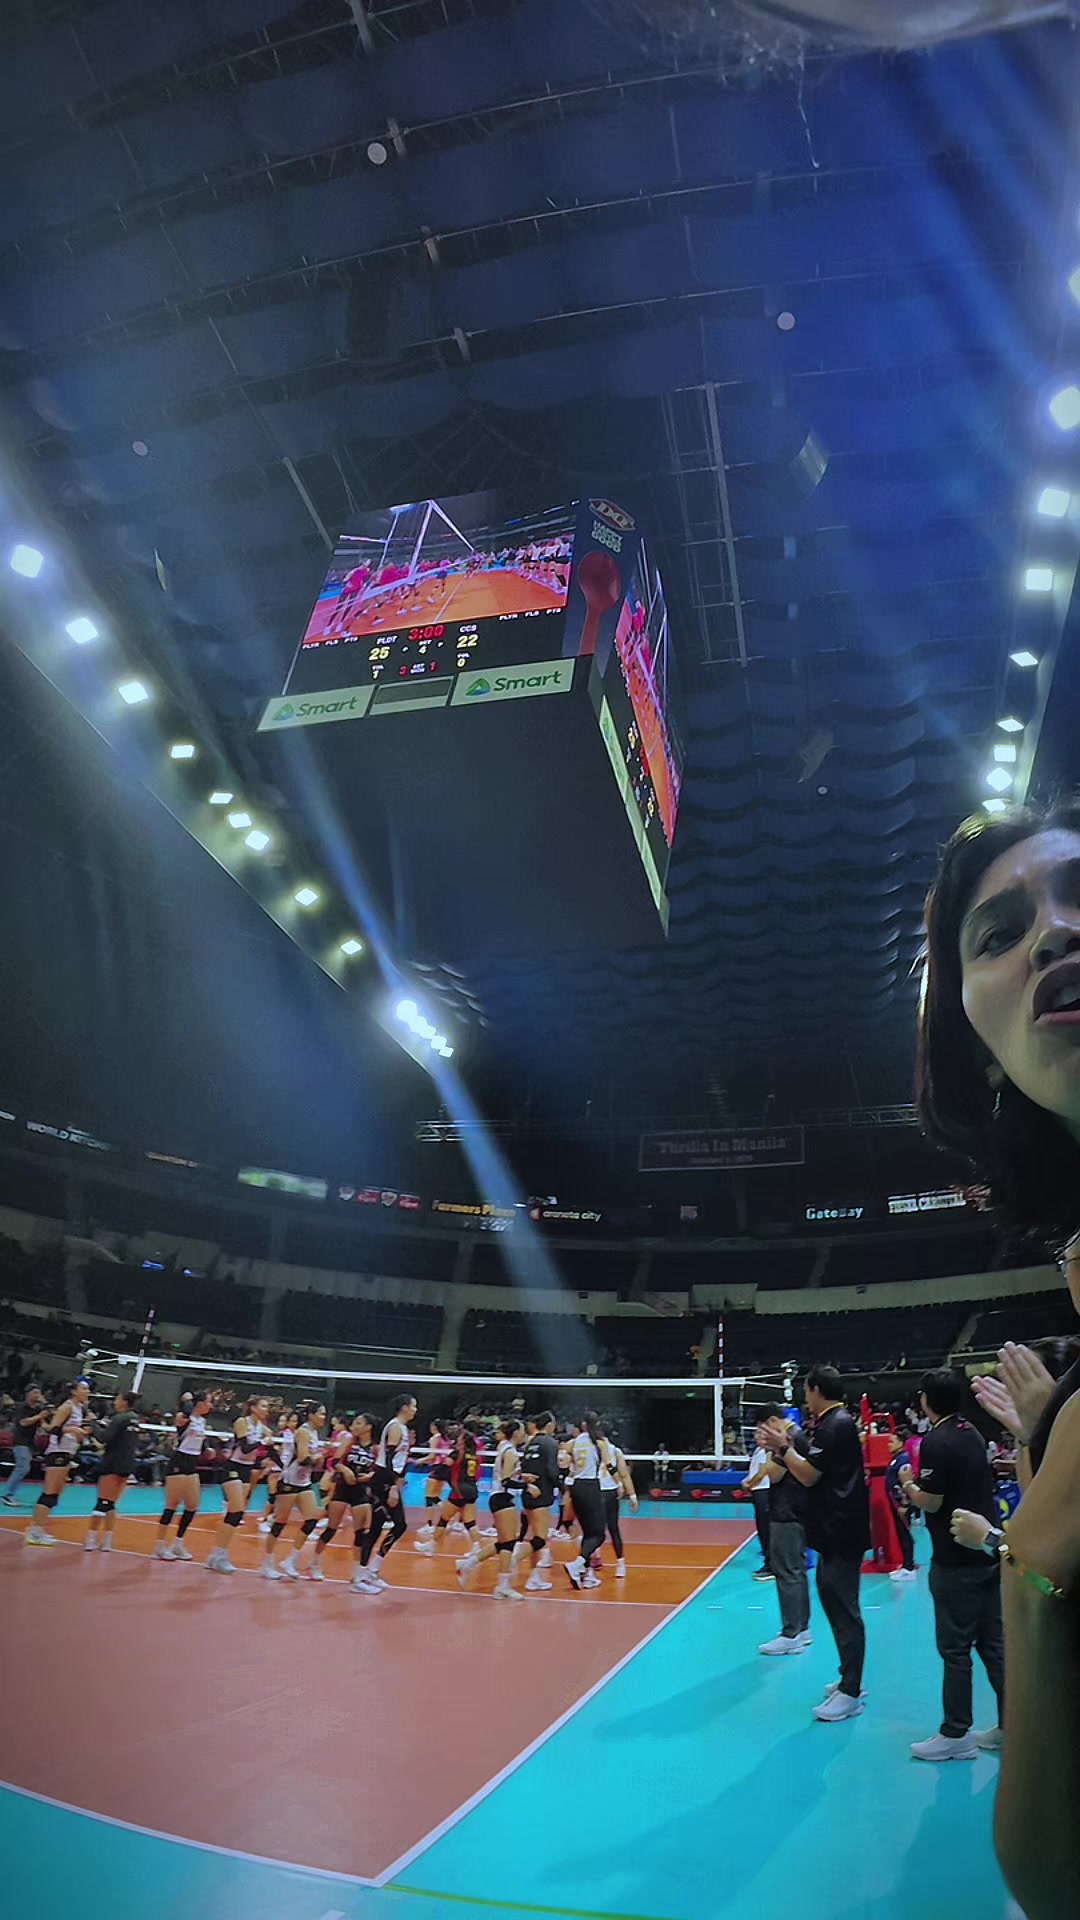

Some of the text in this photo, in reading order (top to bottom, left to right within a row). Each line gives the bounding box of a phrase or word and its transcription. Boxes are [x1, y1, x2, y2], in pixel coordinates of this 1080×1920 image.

[408, 625, 444, 640] 3:00
[459, 624, 478, 633] CCS
[376, 635, 398, 645] PLDT
[456, 634, 479, 648] 22
[368, 646, 390, 661] 25
[457, 658, 466, 668] 0
[399, 665, 408, 676] 3
[493, 671, 562, 692] Smart
[296, 696, 358, 717] Smart
[658, 1136, 786, 1154] Thrilla In Manila
[432, 1199, 481, 1215] Farmers
[581, 1210, 601, 1222] city
